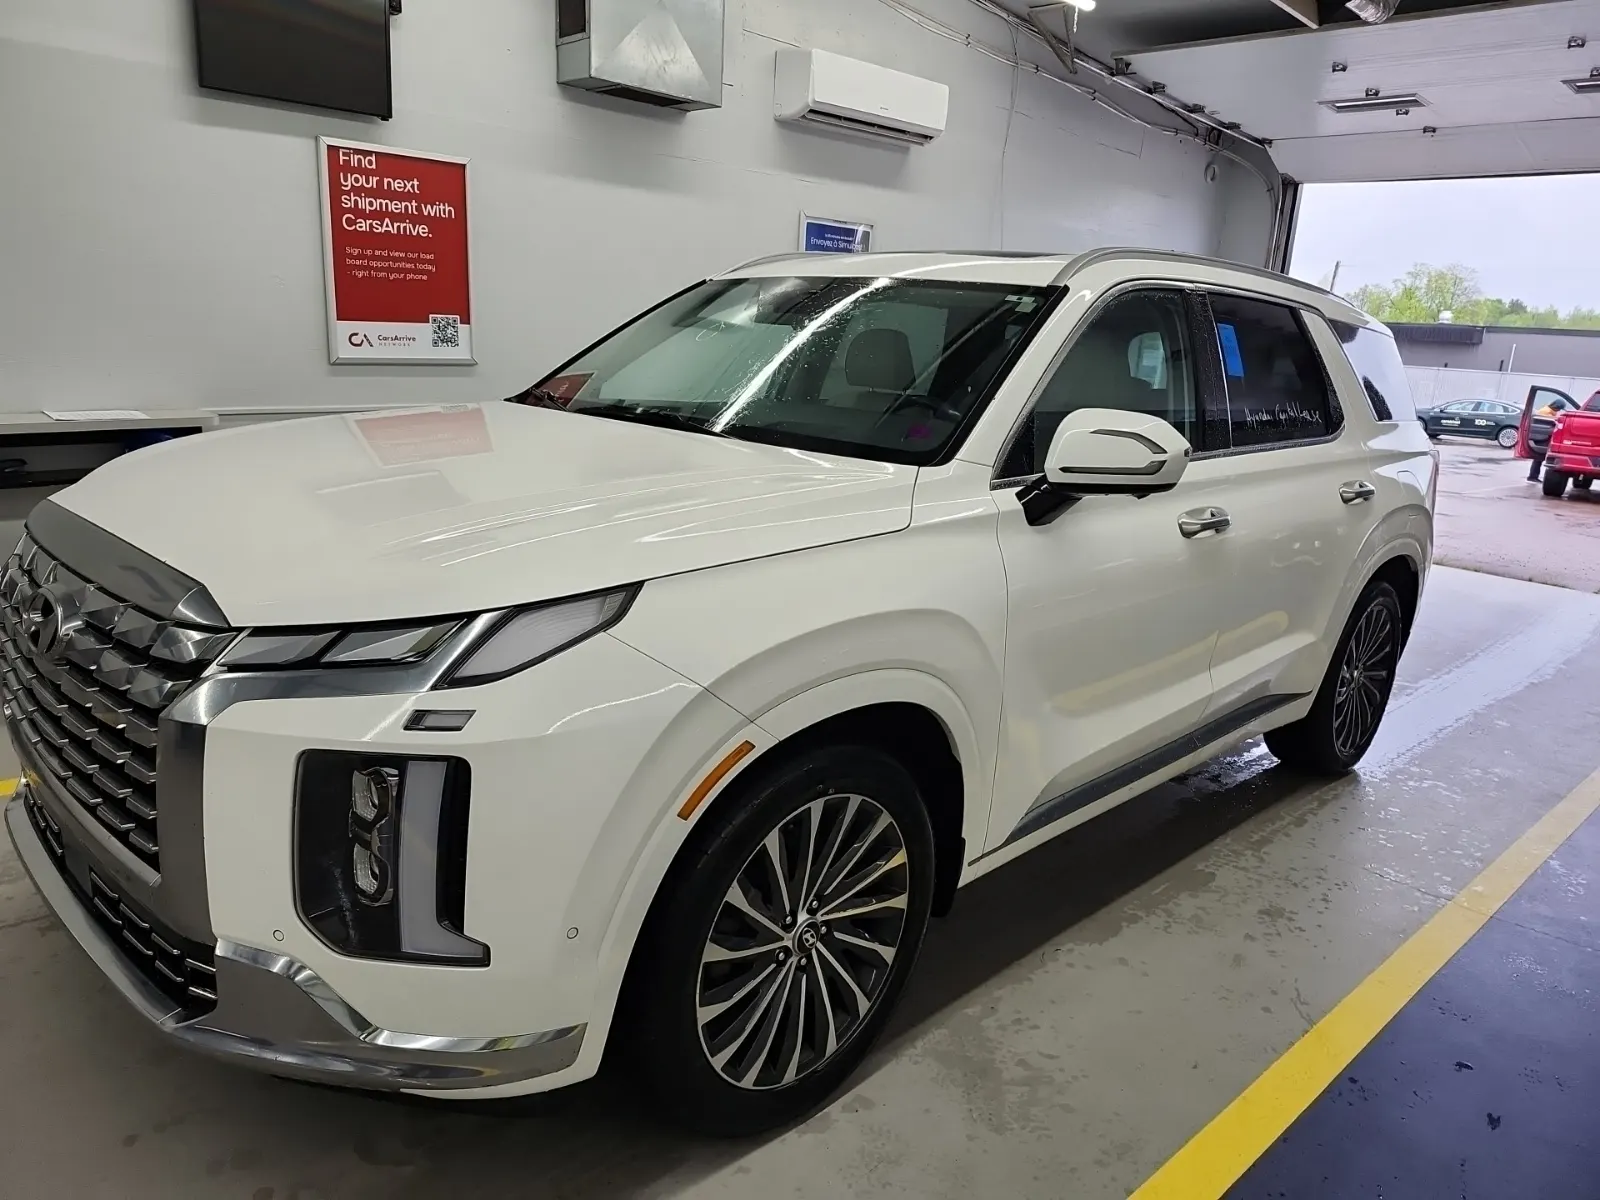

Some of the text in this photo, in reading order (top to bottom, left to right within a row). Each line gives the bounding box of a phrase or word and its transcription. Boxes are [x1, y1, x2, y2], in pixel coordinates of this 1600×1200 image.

[338, 148, 376, 169] Find
[339, 172, 420, 193] your next
[341, 192, 455, 219] shipment with
[342, 213, 433, 238] CarsArrive.
[345, 246, 361, 256] Sign
[374, 249, 388, 257] and
[389, 250, 406, 258] view
[420, 251, 434, 260] load
[345, 257, 436, 273] board opportunities today
[352, 269, 369, 278] right
[370, 269, 387, 278] from
[388, 272, 405, 280] your
[406, 272, 428, 281] phone
[377, 334, 416, 342] CarsArrive
